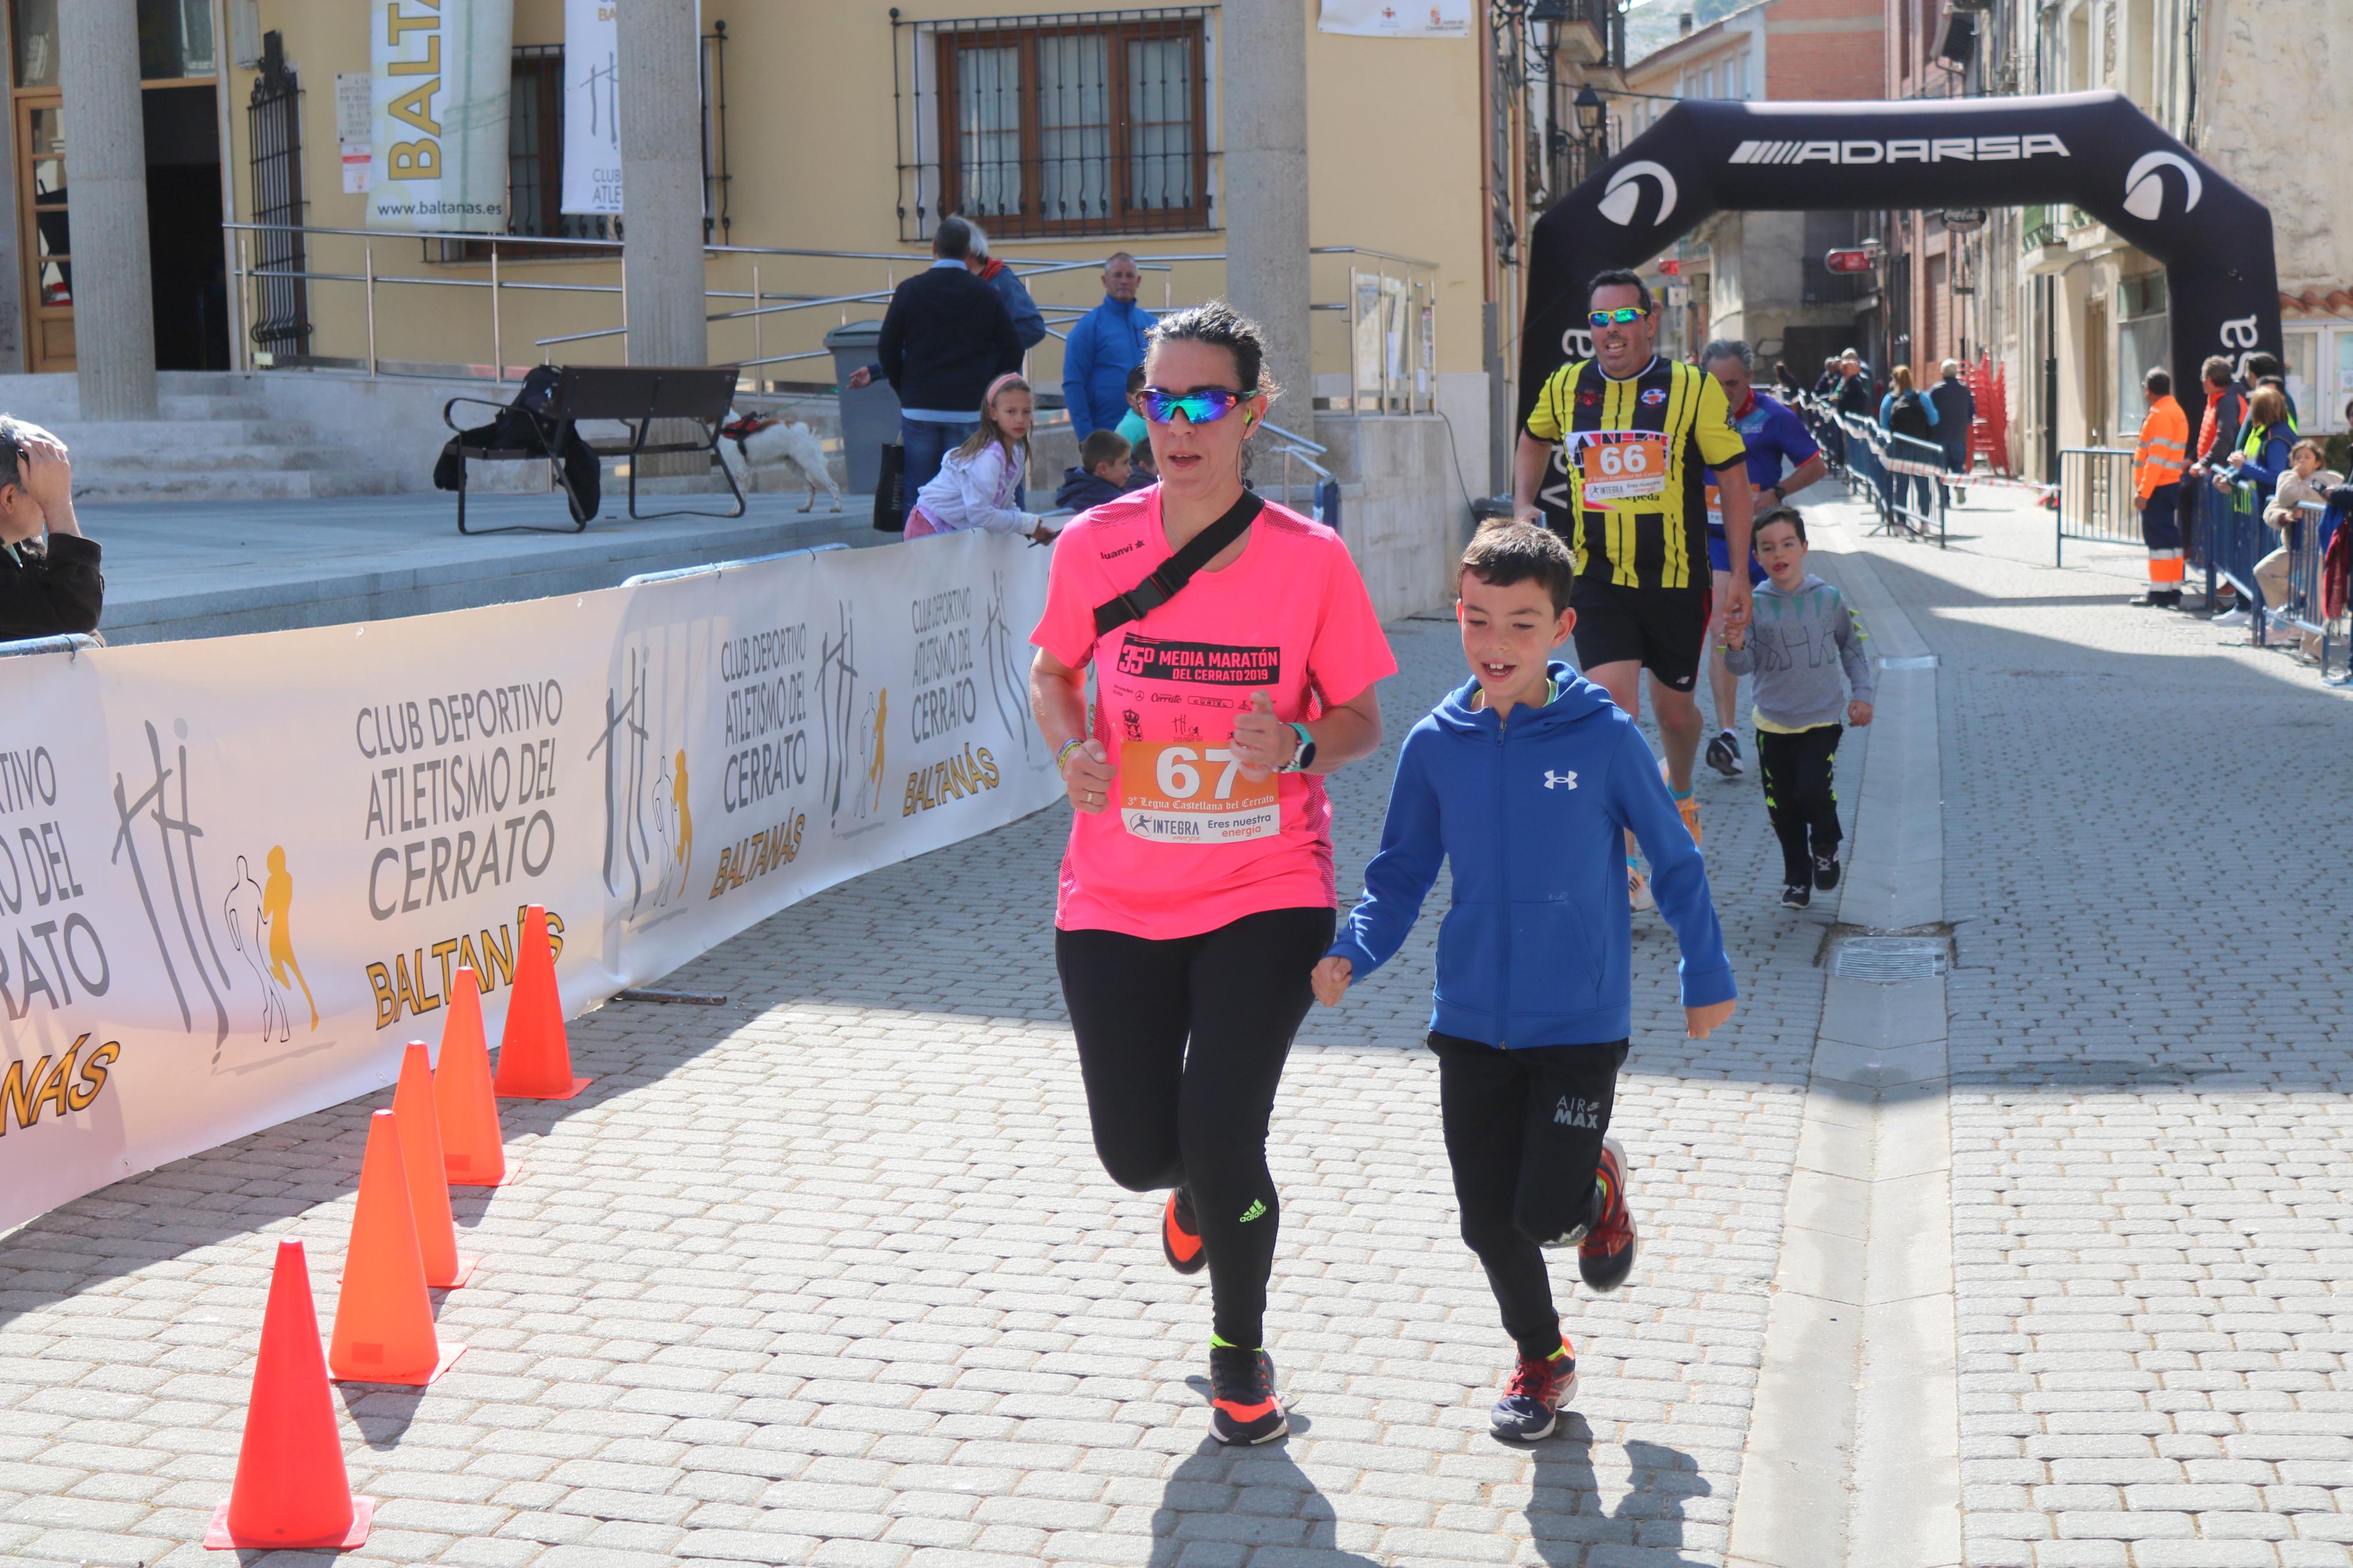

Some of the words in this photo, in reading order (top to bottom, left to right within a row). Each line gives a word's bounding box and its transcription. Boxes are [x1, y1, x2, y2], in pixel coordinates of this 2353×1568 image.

[388, 0, 441, 180] BALT
[1793, 134, 2071, 165] ADARSA
[378, 201, 503, 215] www.baltanas.es
[1600, 445, 1646, 475] 66
[1100, 543, 1133, 559] luanvi
[721, 637, 750, 683] CLUB
[753, 623, 806, 674] DEPORTIVO
[959, 627, 973, 672] DEL
[1159, 650, 1205, 667] MEDIA
[1209, 648, 1278, 668] MARATÓN
[1172, 669, 1192, 680] DEL
[1194, 669, 1243, 681] CERRATO
[1244, 669, 1269, 681] 2019
[725, 676, 786, 748] ATLETISMO
[789, 670, 806, 725] DEL
[912, 677, 976, 744] CERRATO
[1151, 692, 1182, 703] Cerrato
[1193, 699, 1228, 707] CURIEL
[356, 701, 424, 759] CLUB
[428, 679, 563, 746] DEPORTIVO
[0, 746, 56, 814] TIVO
[365, 746, 510, 840] ATLETISMO
[519, 737, 556, 805] DEL
[724, 730, 807, 813] CERRATO
[902, 742, 999, 817] BALTANÁS
[1156, 746, 1241, 799] 67
[1140, 797, 1169, 809] Legua
[1173, 800, 1222, 810] Castellana
[1226, 799, 1238, 809] del
[1241, 795, 1274, 808] Cerrato
[1154, 819, 1199, 835] INTEGRA
[1208, 820, 1230, 829] Eres
[1233, 815, 1271, 827] nuestra
[1222, 824, 1261, 837] energía
[19, 821, 84, 906] DEL
[369, 809, 555, 921] CERRATO
[708, 806, 805, 901] BALTANÁS
[1553, 1108, 1598, 1129] MAX
[1556, 1095, 1586, 1112] AIR
[1240, 1206, 1266, 1222] adidas
